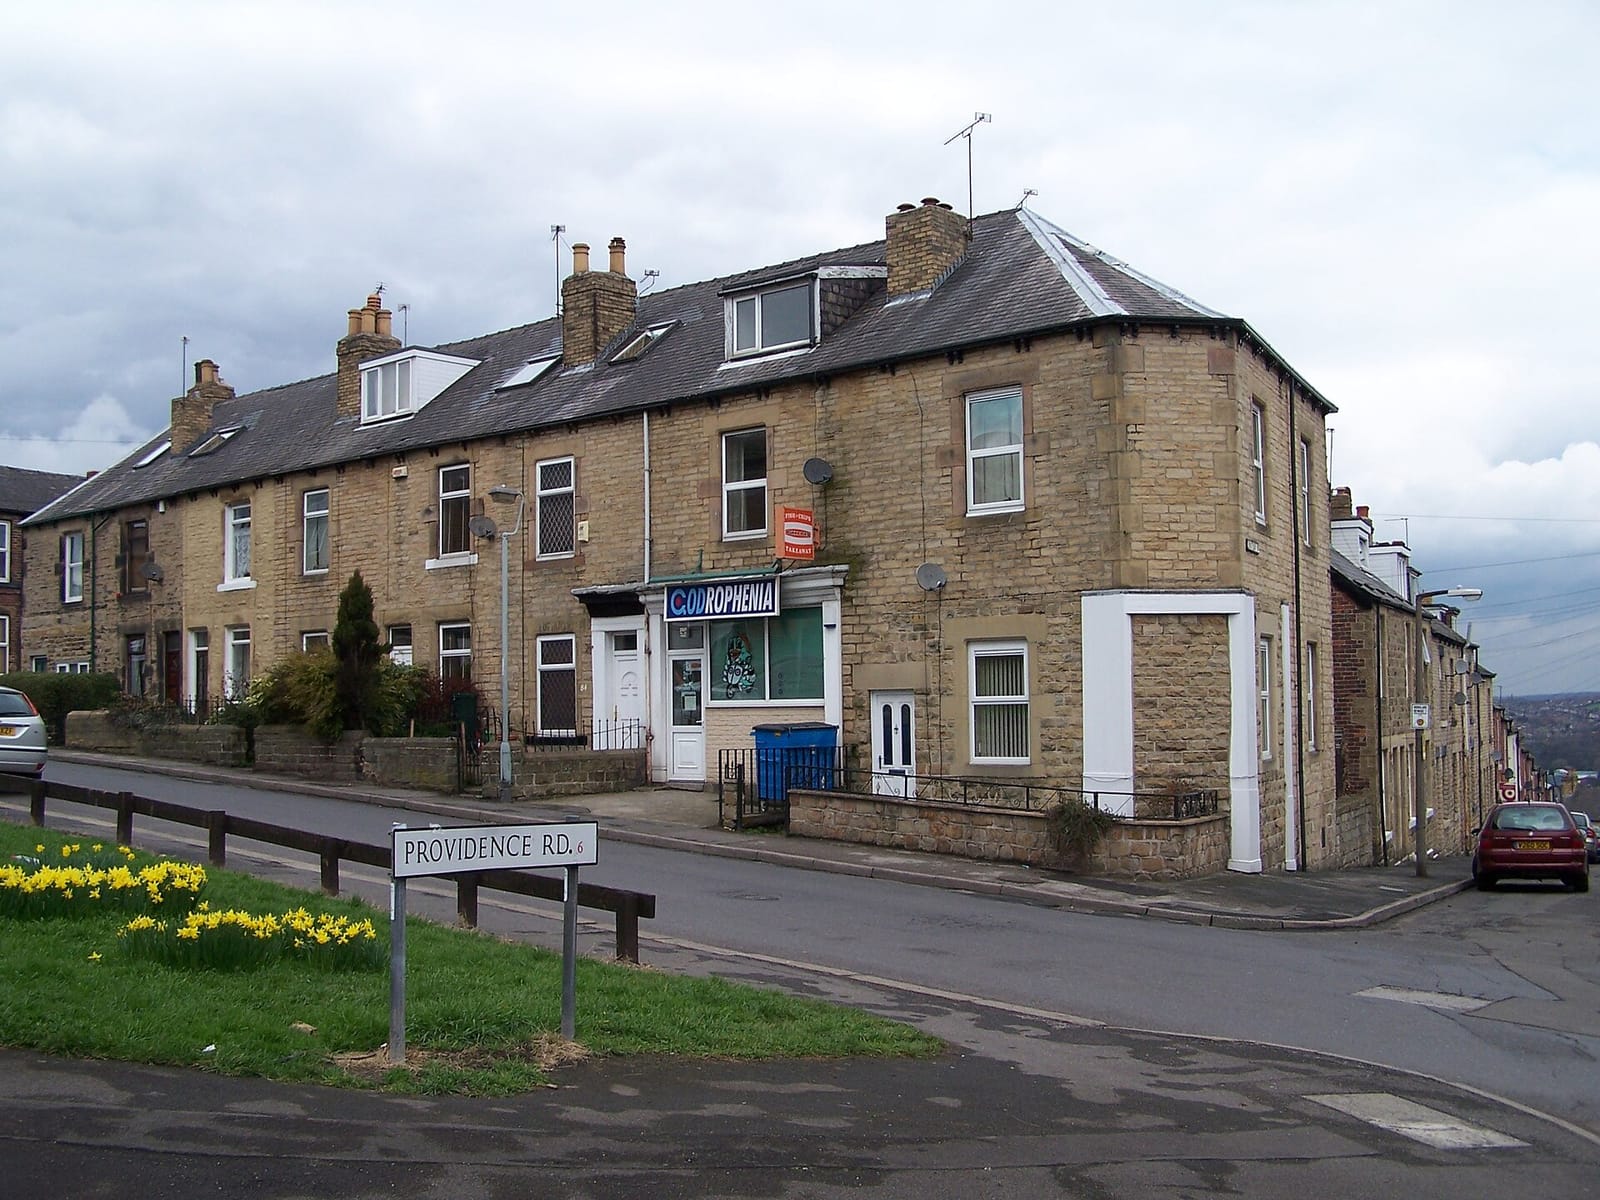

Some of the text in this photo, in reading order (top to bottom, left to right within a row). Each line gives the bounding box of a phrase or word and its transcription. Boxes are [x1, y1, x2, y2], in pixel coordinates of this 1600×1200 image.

[405, 833, 584, 865] PROVIDENCE RD. 6
